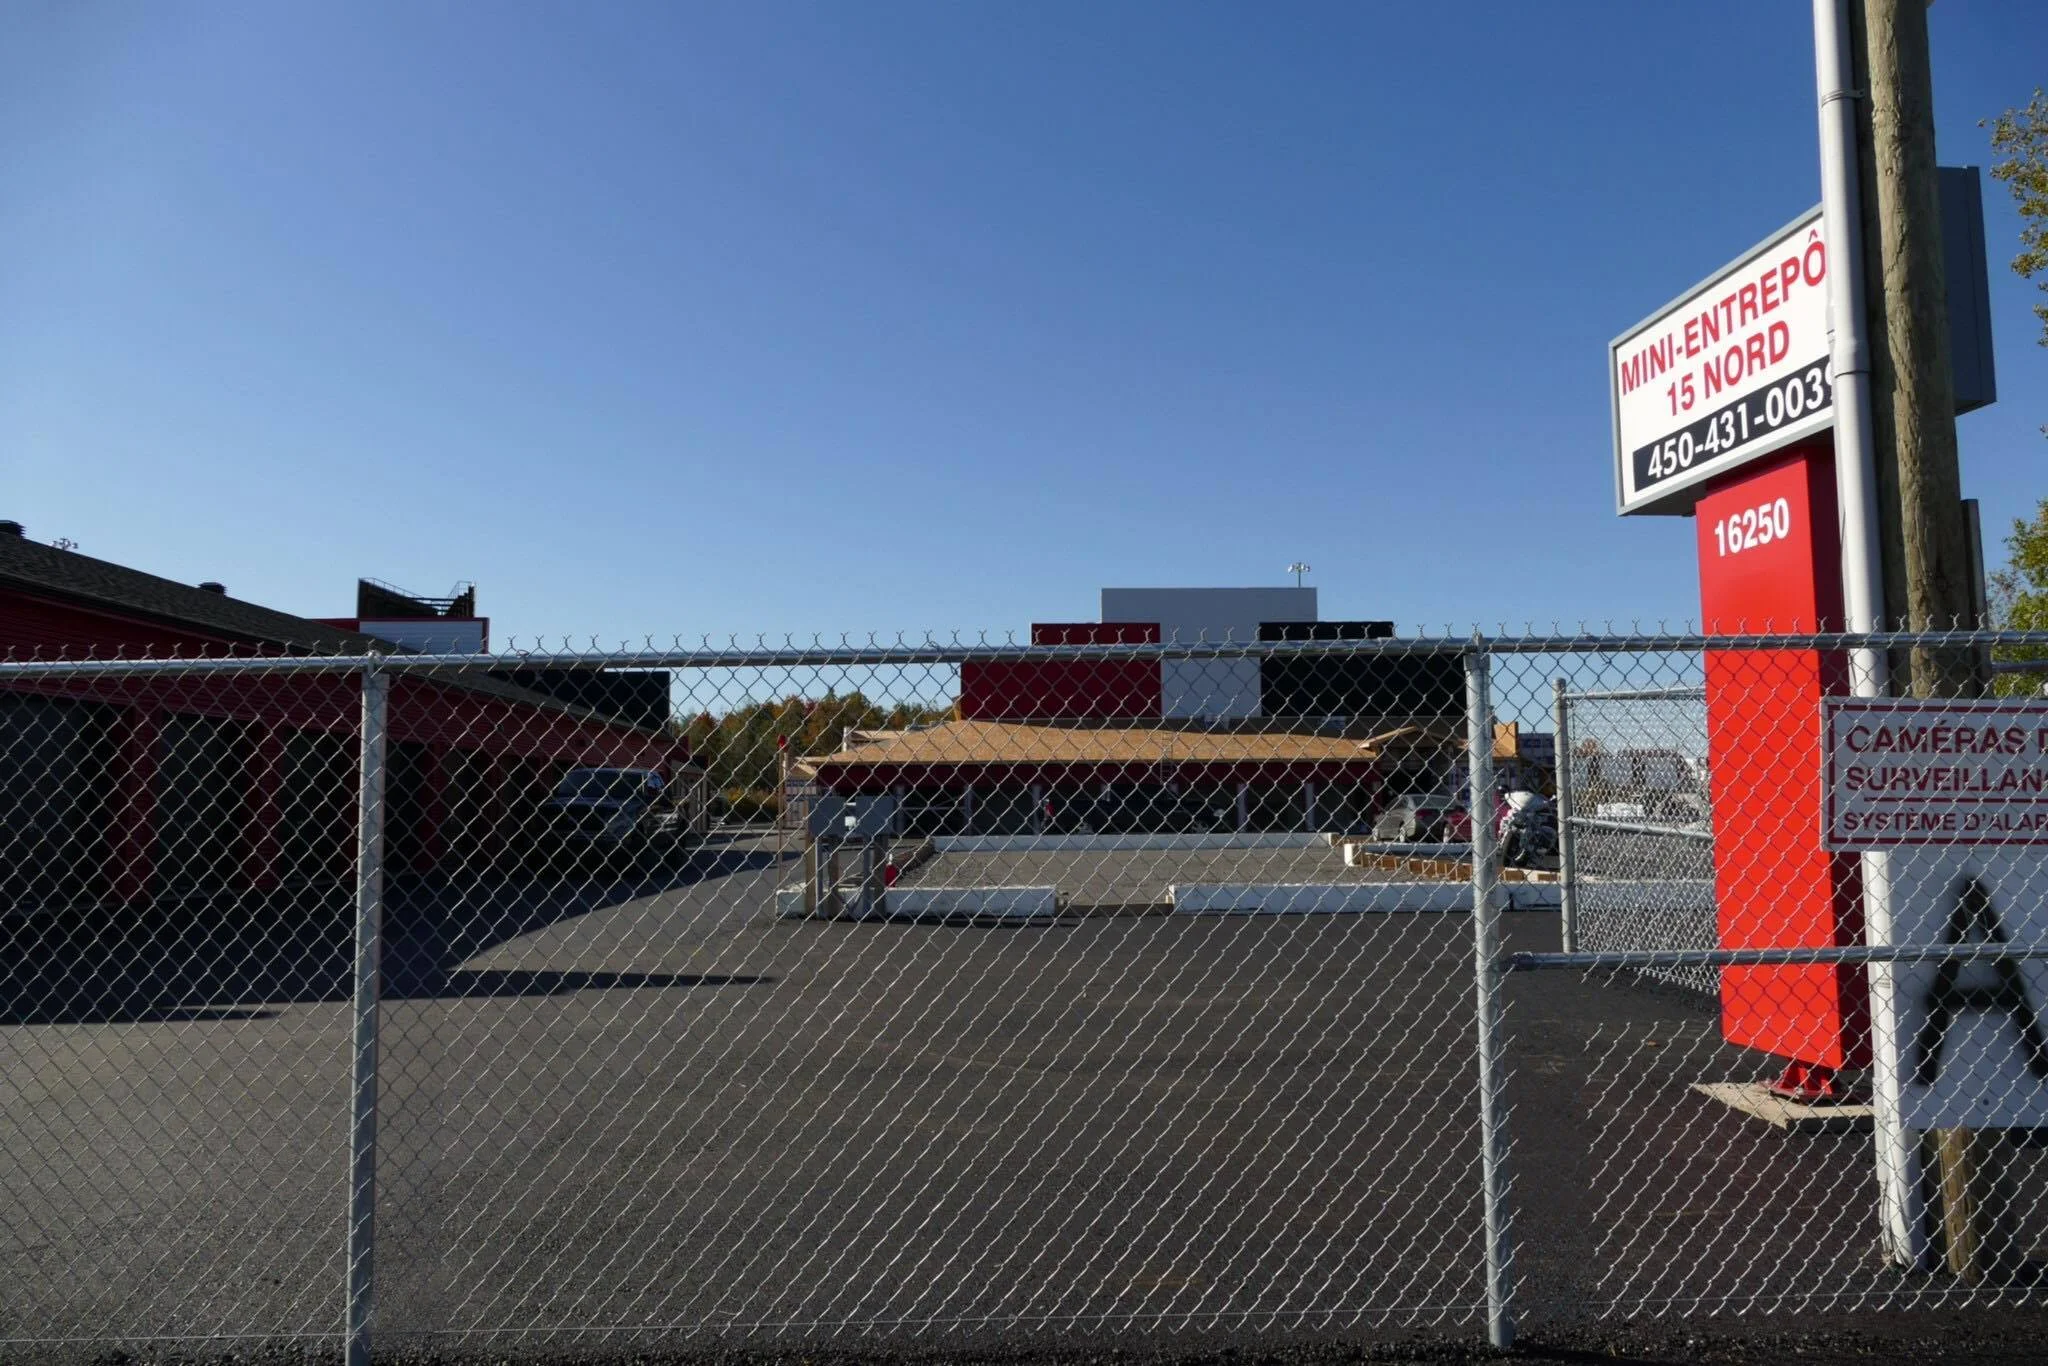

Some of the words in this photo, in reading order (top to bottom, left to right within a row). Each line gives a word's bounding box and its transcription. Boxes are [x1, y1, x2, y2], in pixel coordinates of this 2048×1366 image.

[1666, 372, 1696, 417] 15
[1703, 320, 1790, 399] NORD
[1714, 497, 1790, 557] 16250
[1846, 719, 2027, 754] CAMÉRAS
[1846, 766, 2048, 792] SURVEILLAN
[1843, 807, 1956, 832] SYSTÈME
